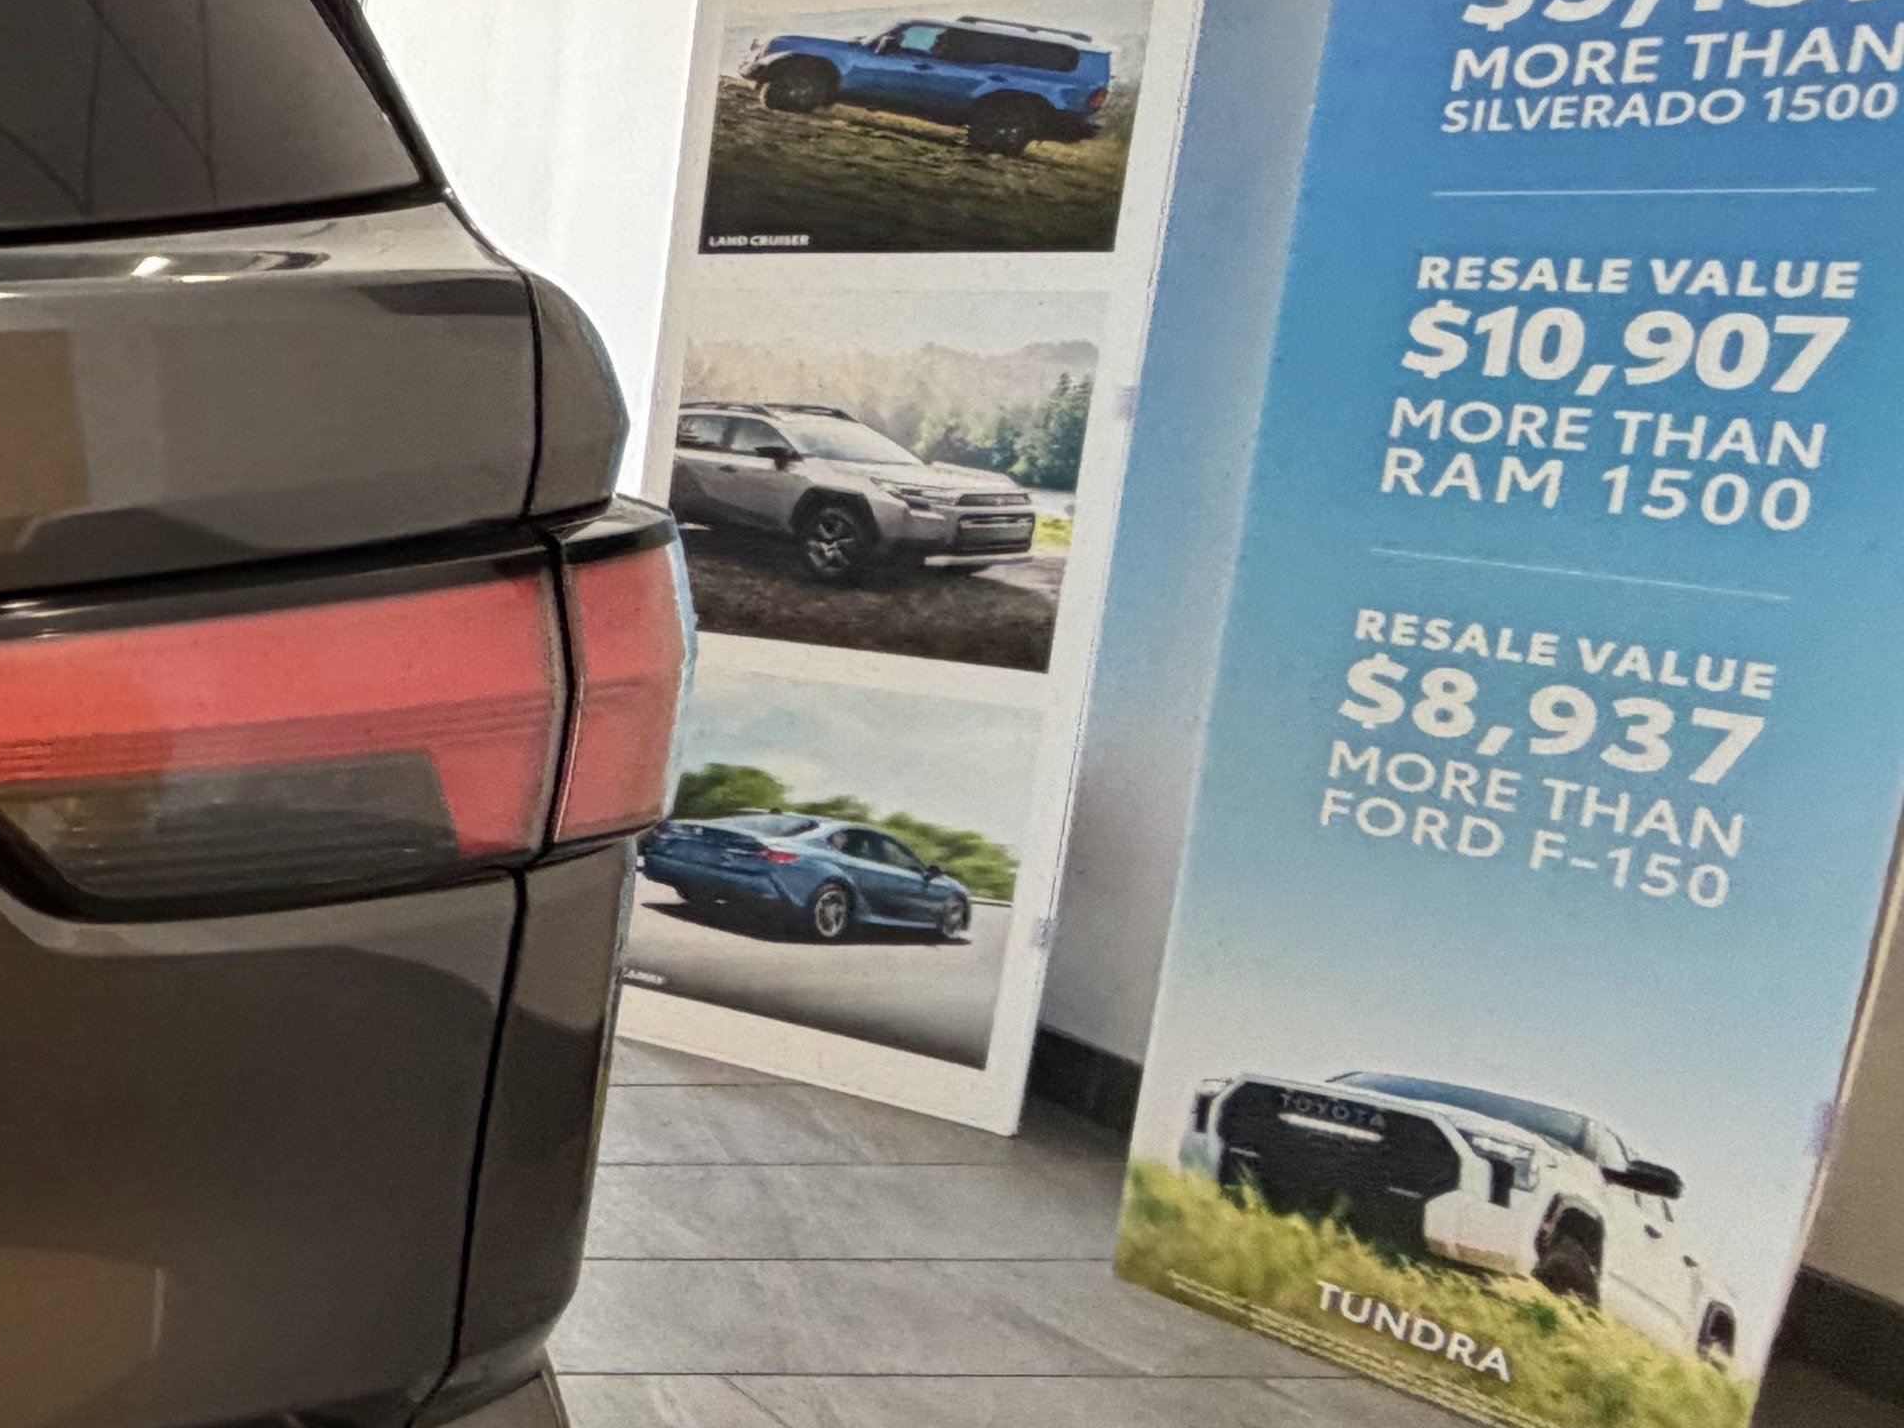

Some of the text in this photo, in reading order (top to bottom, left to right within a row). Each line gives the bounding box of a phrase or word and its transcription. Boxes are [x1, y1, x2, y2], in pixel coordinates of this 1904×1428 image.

[1449, 21, 1904, 92] MORE THAN
[1440, 80, 1898, 133] SILVERADO 1500
[708, 233, 810, 248] LAND CRUISER
[1416, 255, 1862, 300] RESALE VALUE
[1400, 299, 1851, 397] $10,907
[1387, 397, 1828, 470] MORE THAN
[1379, 447, 1813, 532] RAM 1500
[1353, 608, 1779, 701] RESALE VALUE
[1337, 653, 1767, 786] $8,937
[1326, 740, 1746, 859] MORE THAN
[1318, 787, 1731, 909] FORD F-150
[1315, 1280, 1512, 1383] TUNDRA
